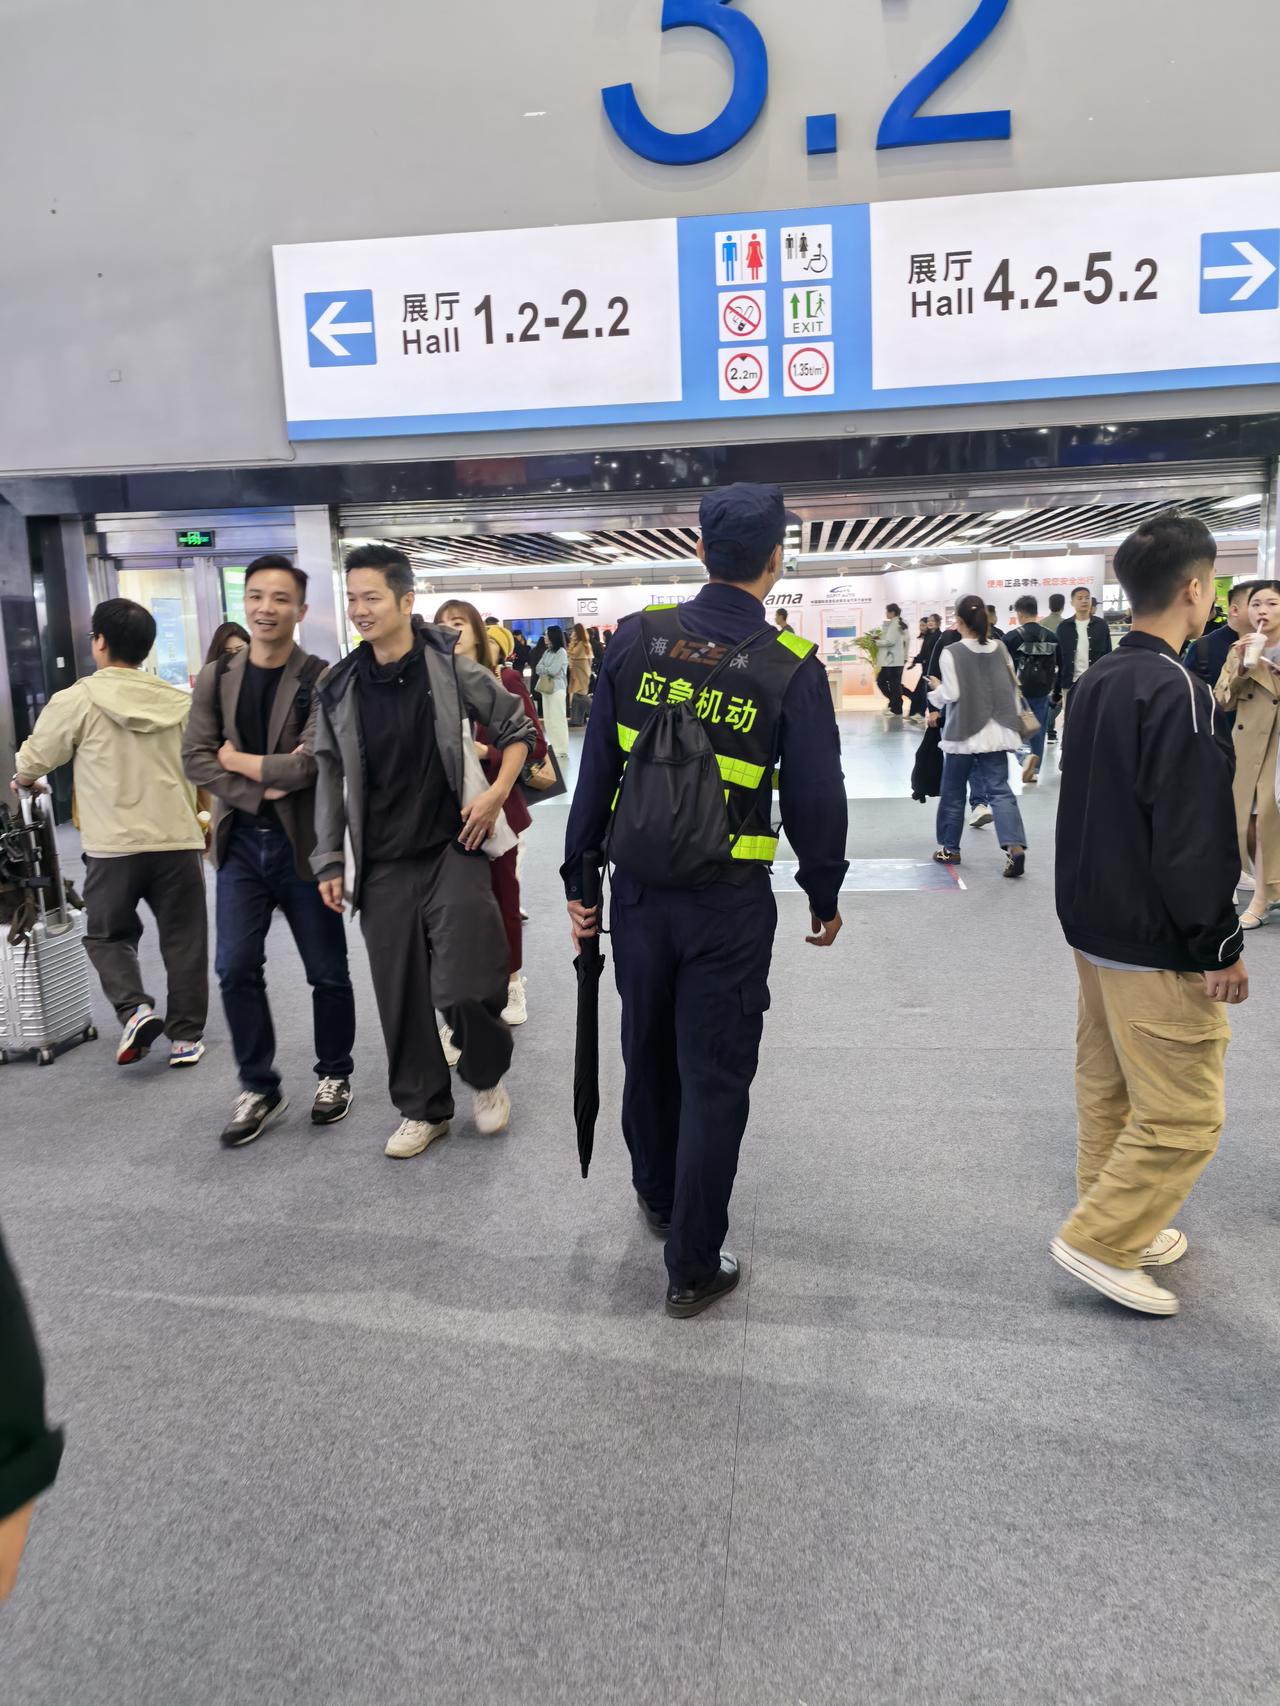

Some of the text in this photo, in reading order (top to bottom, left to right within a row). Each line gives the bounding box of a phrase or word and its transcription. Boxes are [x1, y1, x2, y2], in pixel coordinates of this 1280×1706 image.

[601, 0, 1011, 166] 3.2
[907, 250, 973, 285] 展厅
[911, 251, 1158, 318] Hall 4.2-5.2
[402, 291, 460, 323] 展厅
[403, 288, 630, 355] Hall 1.2-2.2
[792, 321, 824, 334] EXIT
[730, 367, 758, 380] 2.2m
[764, 593, 803, 605] ama
[649, 636, 669, 656] 海
[635, 671, 758, 733] 应急机动
